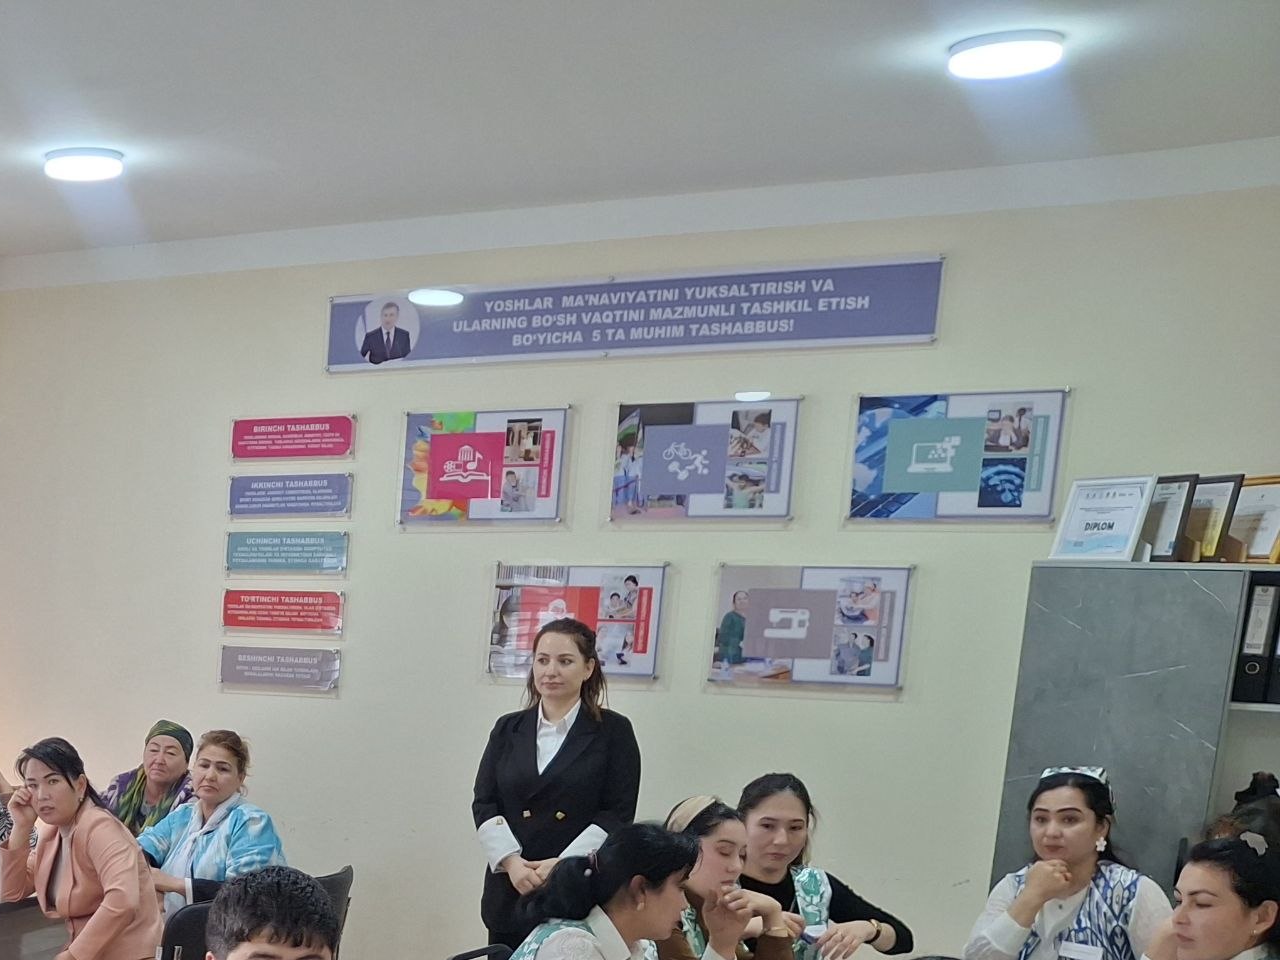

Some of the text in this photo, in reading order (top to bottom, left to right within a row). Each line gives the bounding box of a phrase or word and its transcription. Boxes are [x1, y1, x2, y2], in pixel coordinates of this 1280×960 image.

[484, 278, 835, 313] YOSHLAR MA'NAVIYATINI YUKSALTIRISH VA
[452, 316, 528, 333] ULARNING
[582, 308, 645, 325] VAQTINI
[649, 303, 736, 321] MAZMUNLI
[740, 298, 813, 315] TASHKIL
[817, 295, 871, 311] ETISH
[591, 330, 601, 342] 5
[605, 328, 626, 341] TA
[629, 324, 685, 340] MUHIM
[688, 319, 795, 337] TASHABBUS!
[253, 423, 330, 433] BIRINCHI TASHABBUS
[1084, 521, 1115, 531] DIPLOM
